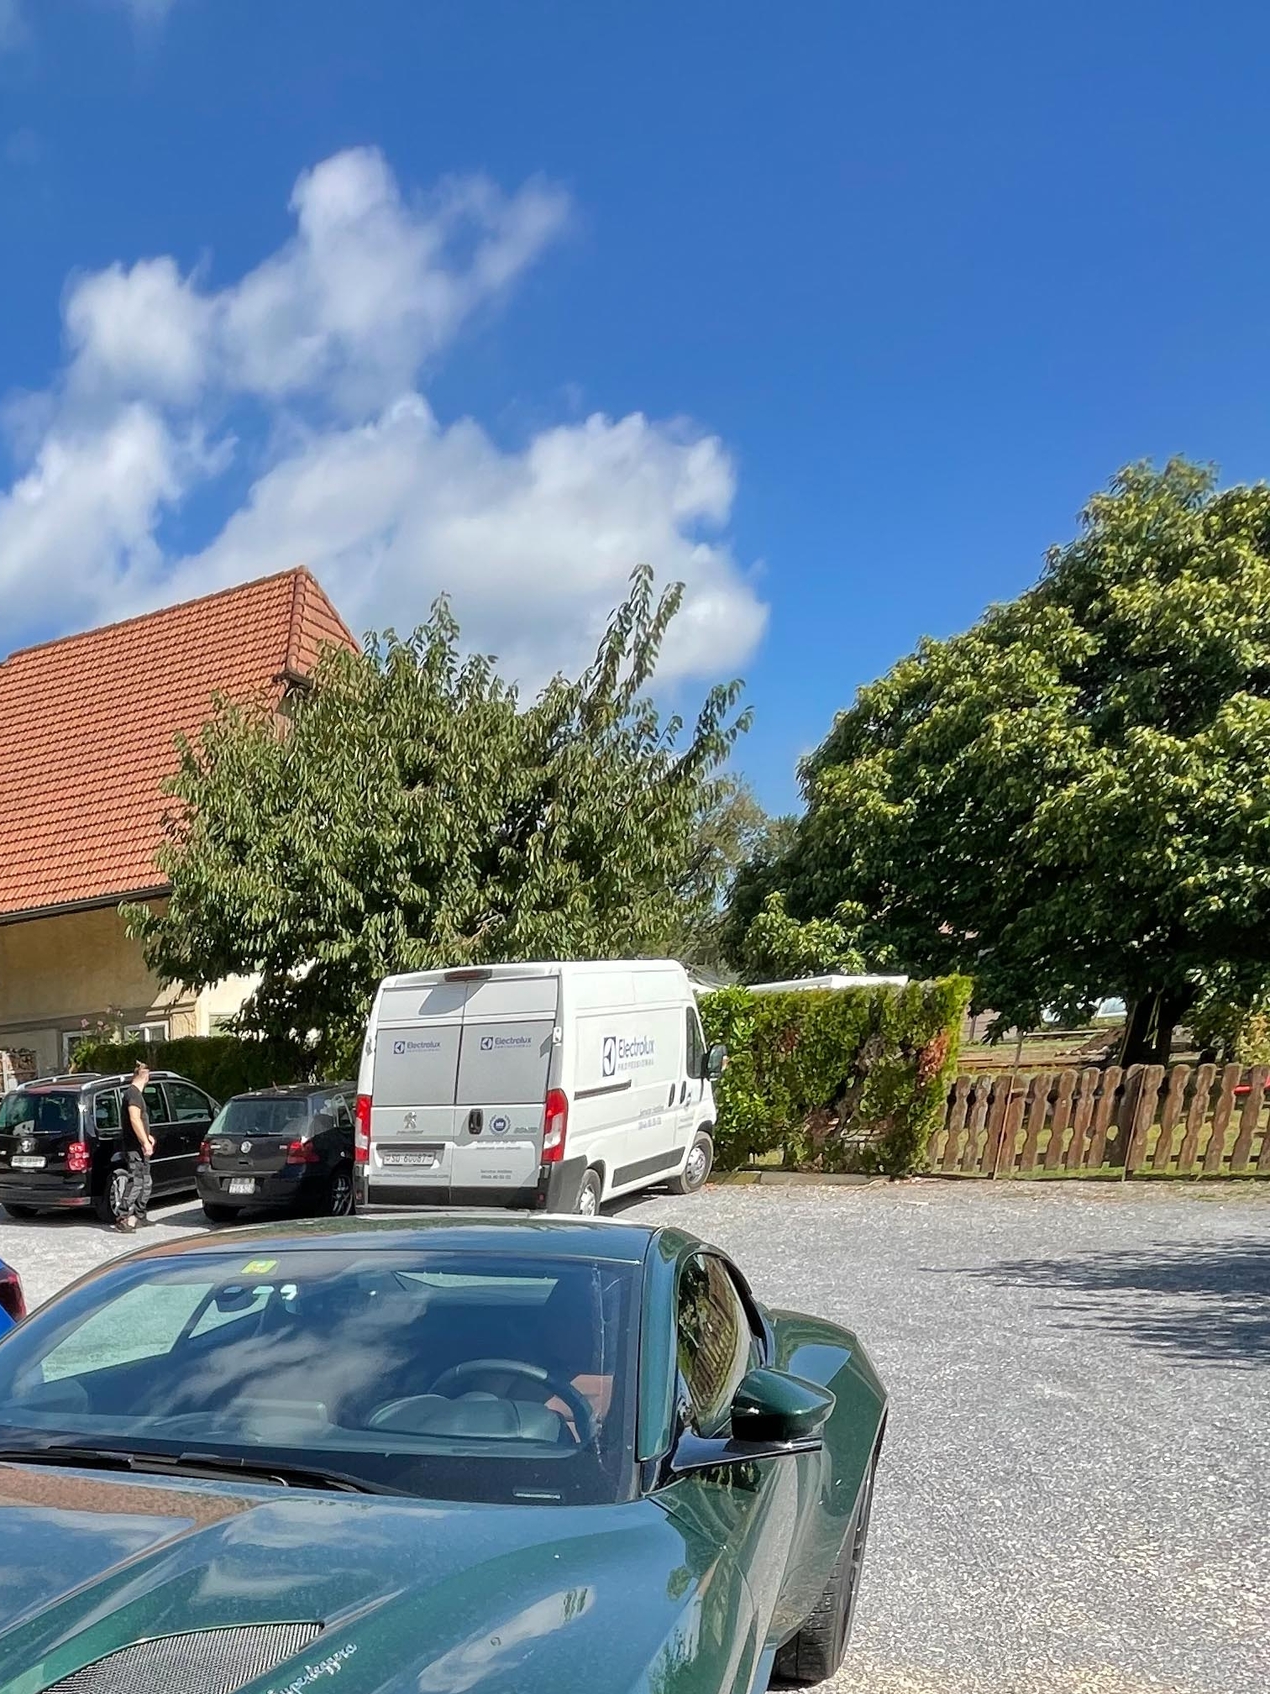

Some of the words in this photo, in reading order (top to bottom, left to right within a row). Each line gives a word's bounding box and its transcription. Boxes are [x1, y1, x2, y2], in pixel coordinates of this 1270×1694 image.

[407, 1041, 440, 1049] Electrolux
[495, 1036, 531, 1045] Electrolux
[619, 1035, 654, 1059] Electrolux
